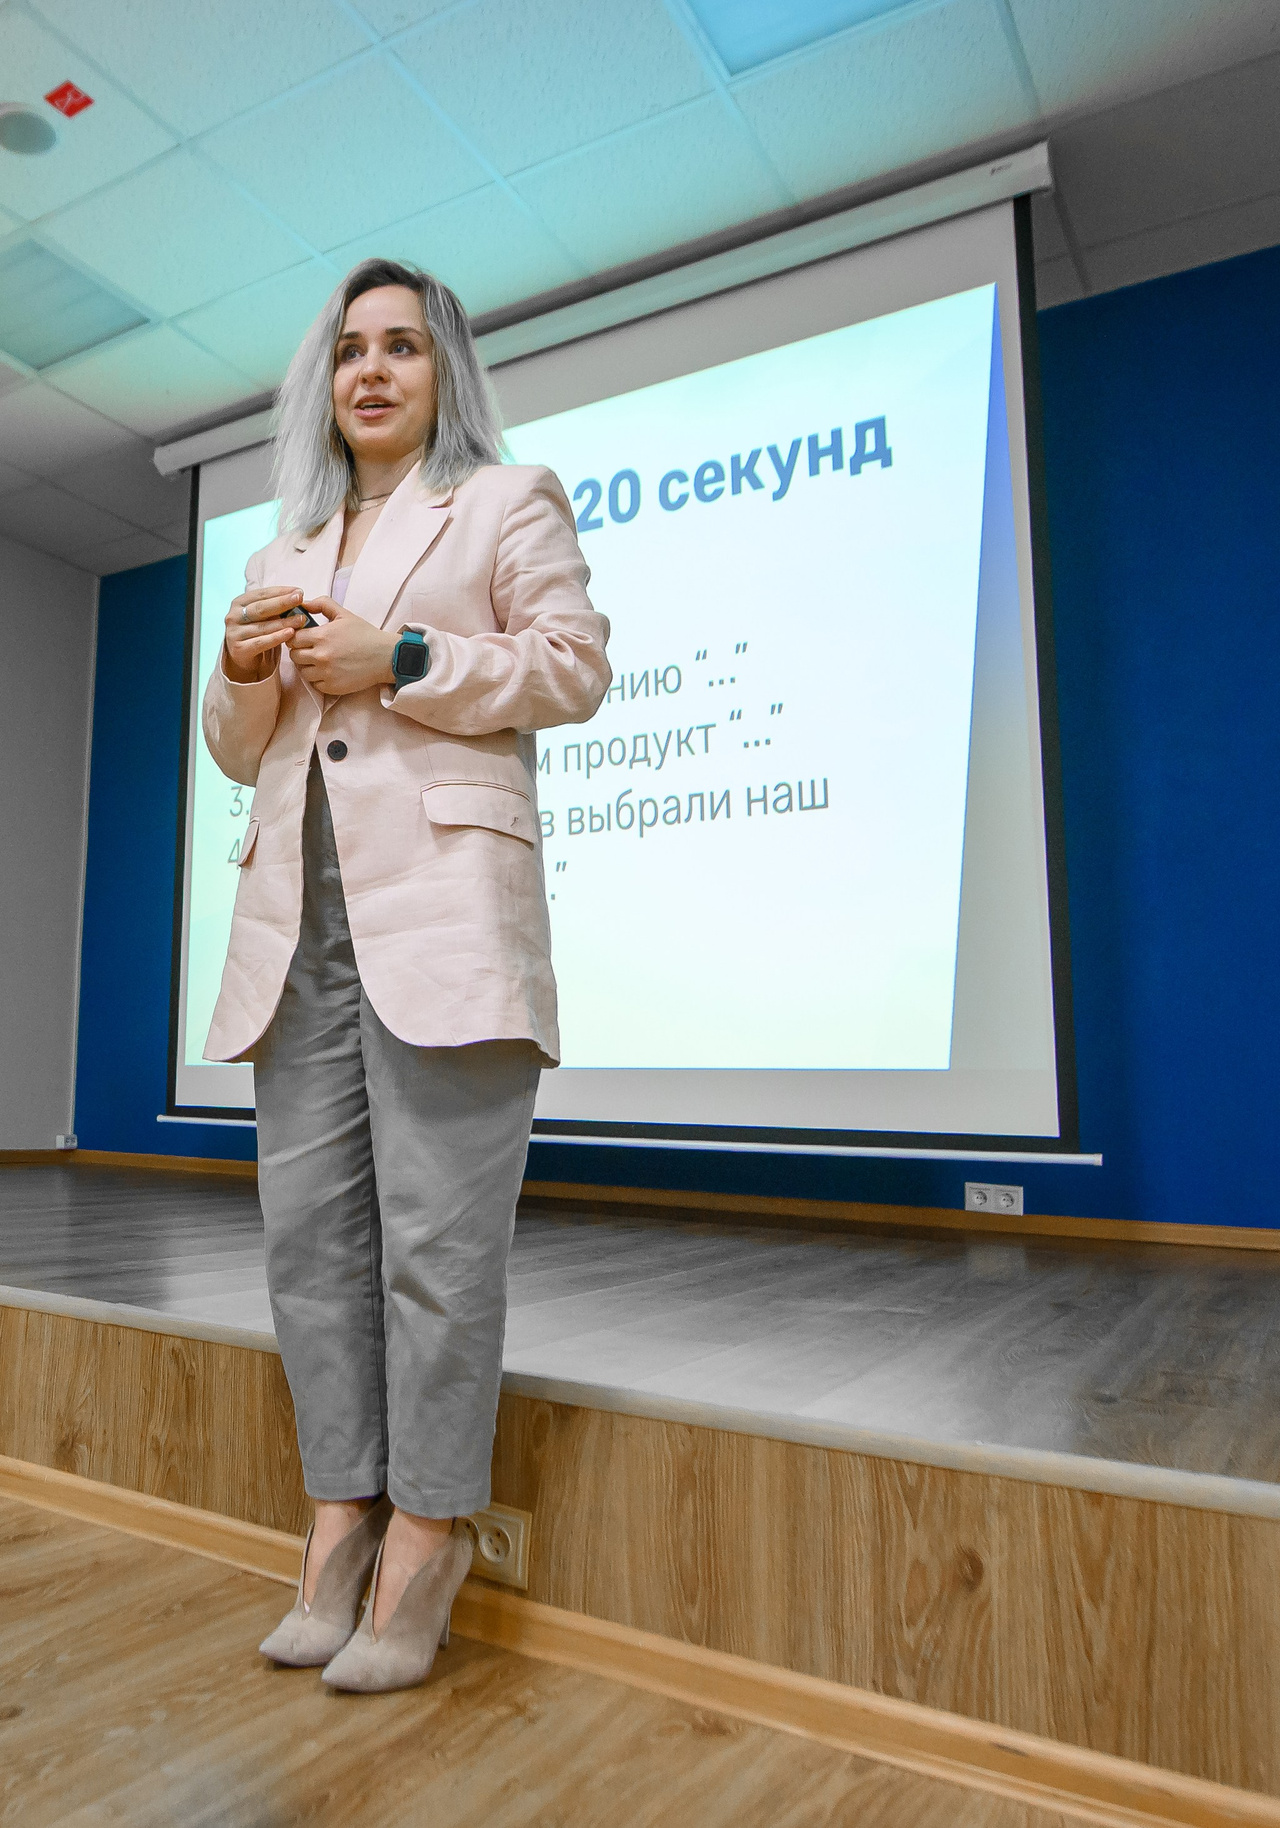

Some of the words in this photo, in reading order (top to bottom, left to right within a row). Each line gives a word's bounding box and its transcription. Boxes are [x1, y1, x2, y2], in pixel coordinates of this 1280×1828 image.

[572, 468, 641, 533] 20
[658, 414, 893, 512] секунд
[564, 723, 717, 779] продукт
[568, 788, 731, 838] выбрали
[746, 777, 829, 817] наш
